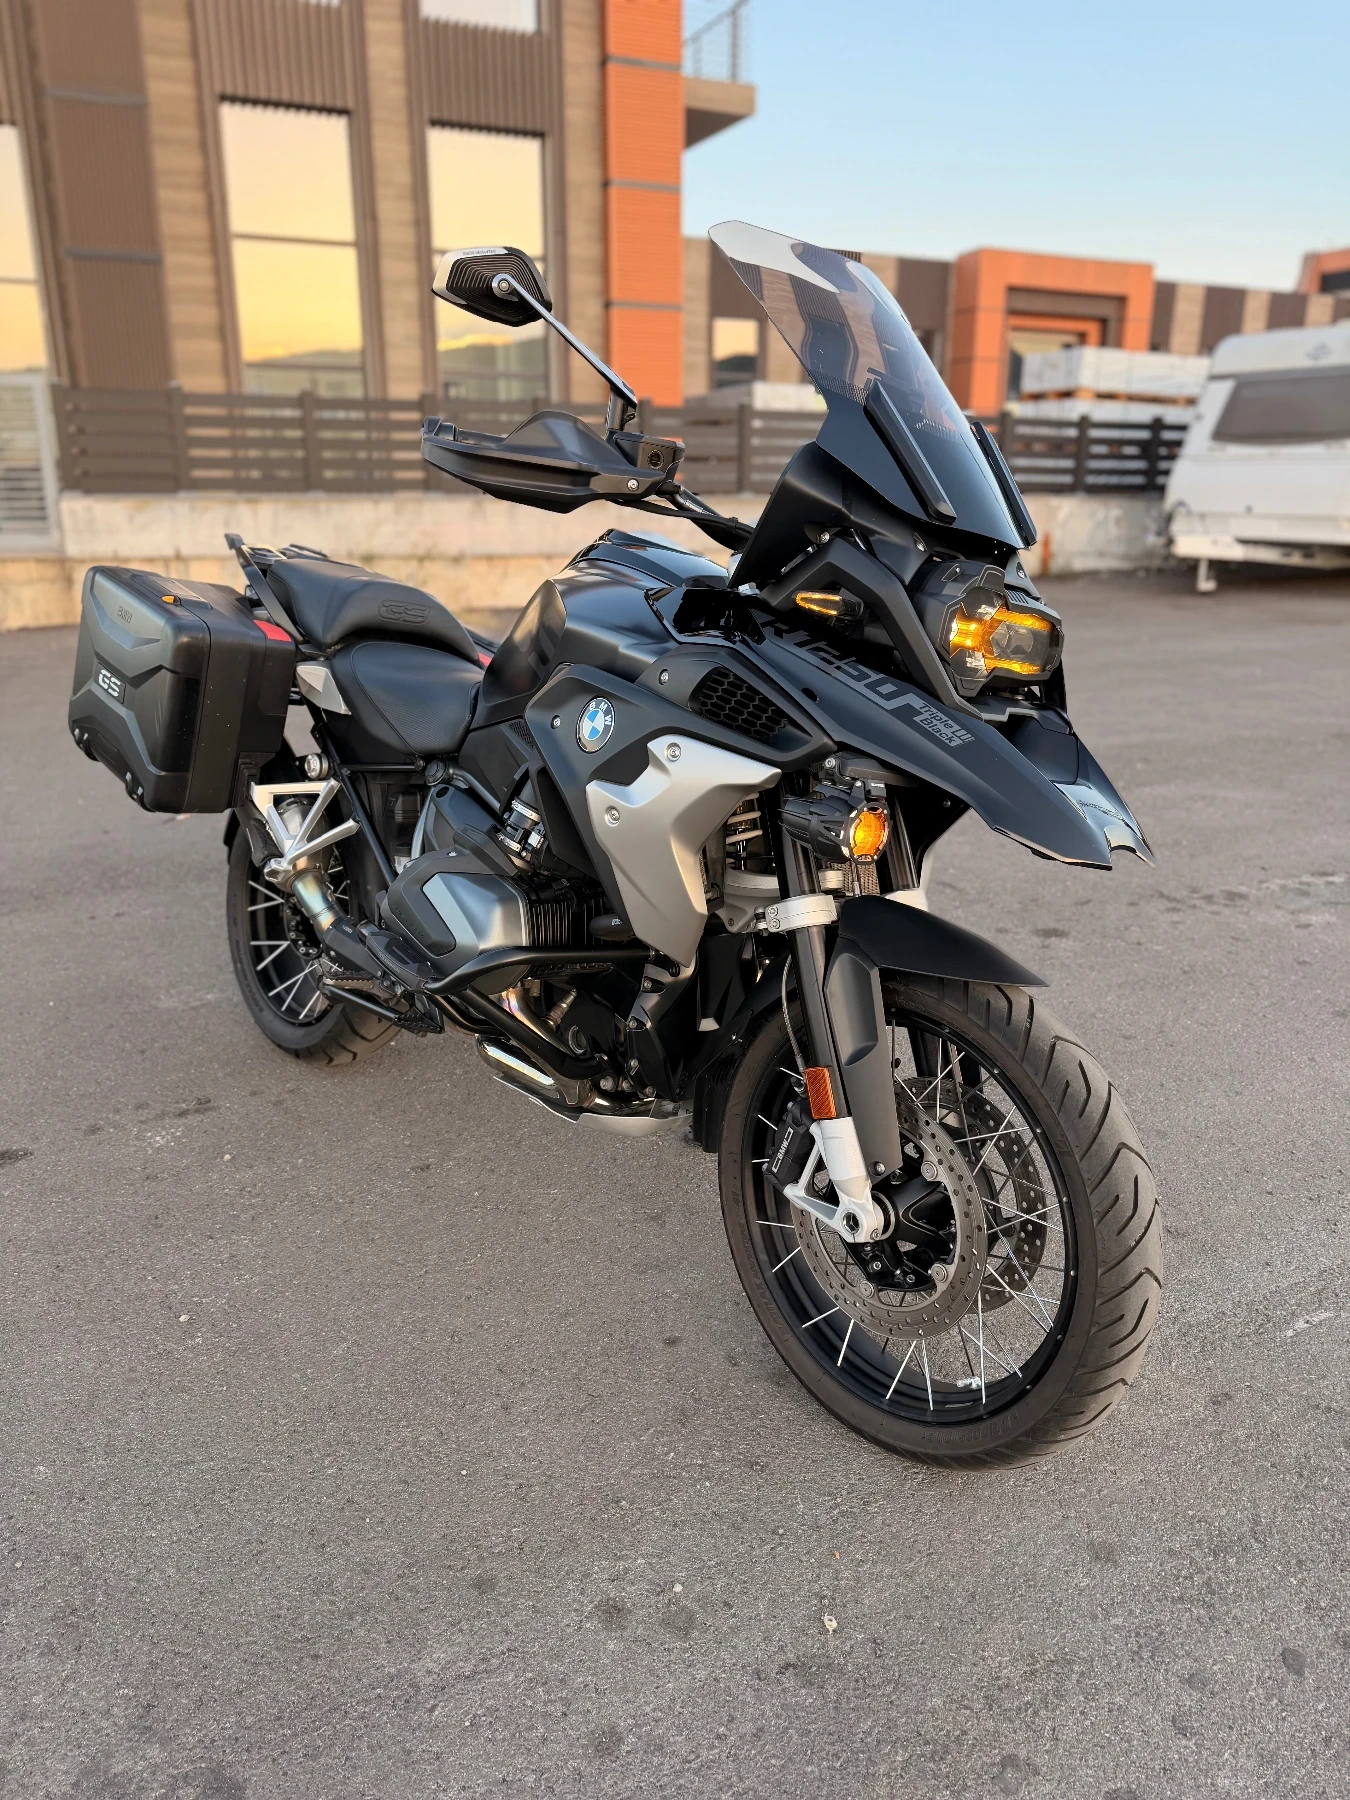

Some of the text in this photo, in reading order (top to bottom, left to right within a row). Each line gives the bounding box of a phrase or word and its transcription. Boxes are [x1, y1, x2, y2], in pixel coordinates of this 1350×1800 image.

[379, 599, 431, 626] GS
[98, 669, 122, 697] GS
[589, 701, 612, 726] BMW
[919, 702, 954, 730] Triple
[919, 717, 956, 744] Black
[777, 1138, 789, 1160] BMW
